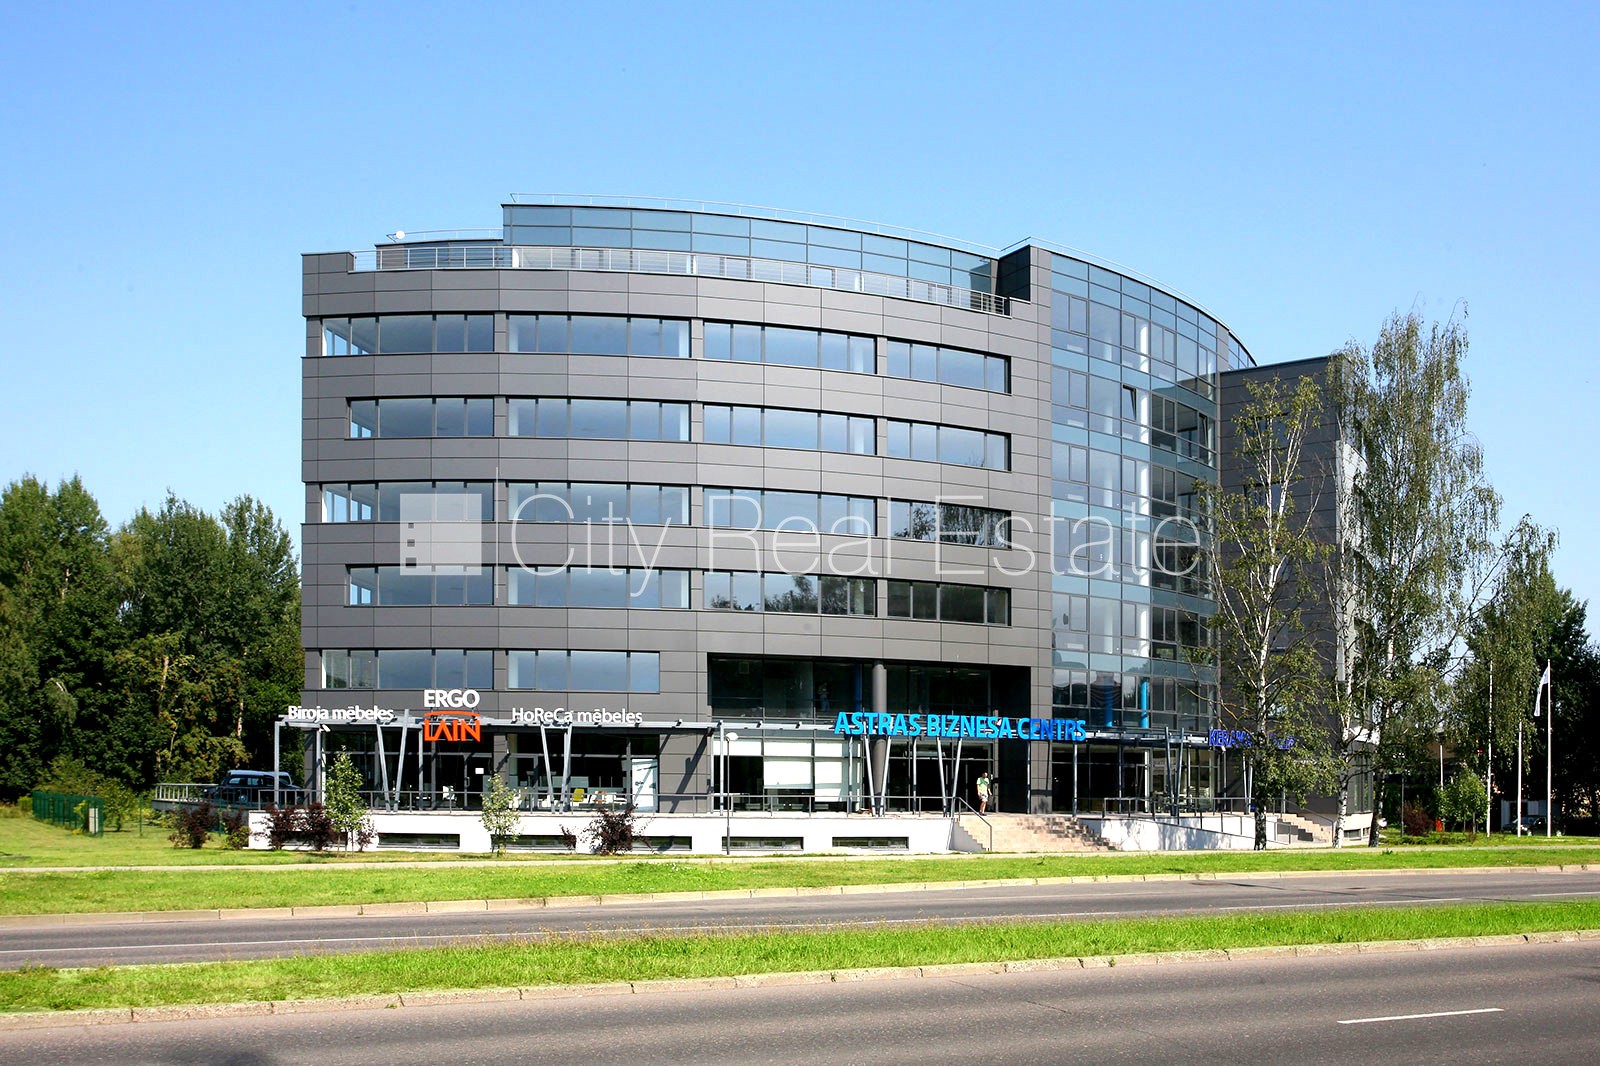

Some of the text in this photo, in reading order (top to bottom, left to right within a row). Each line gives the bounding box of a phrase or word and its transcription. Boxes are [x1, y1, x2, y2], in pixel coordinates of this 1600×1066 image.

[424, 689, 480, 708] ERGO
[287, 705, 394, 723] Biroja mēbeles
[512, 707, 643, 723] HoReCa mēbeles
[424, 719, 480, 742] LAIN
[834, 711, 1087, 742] ASTRAS BIZNESA CENTRS
